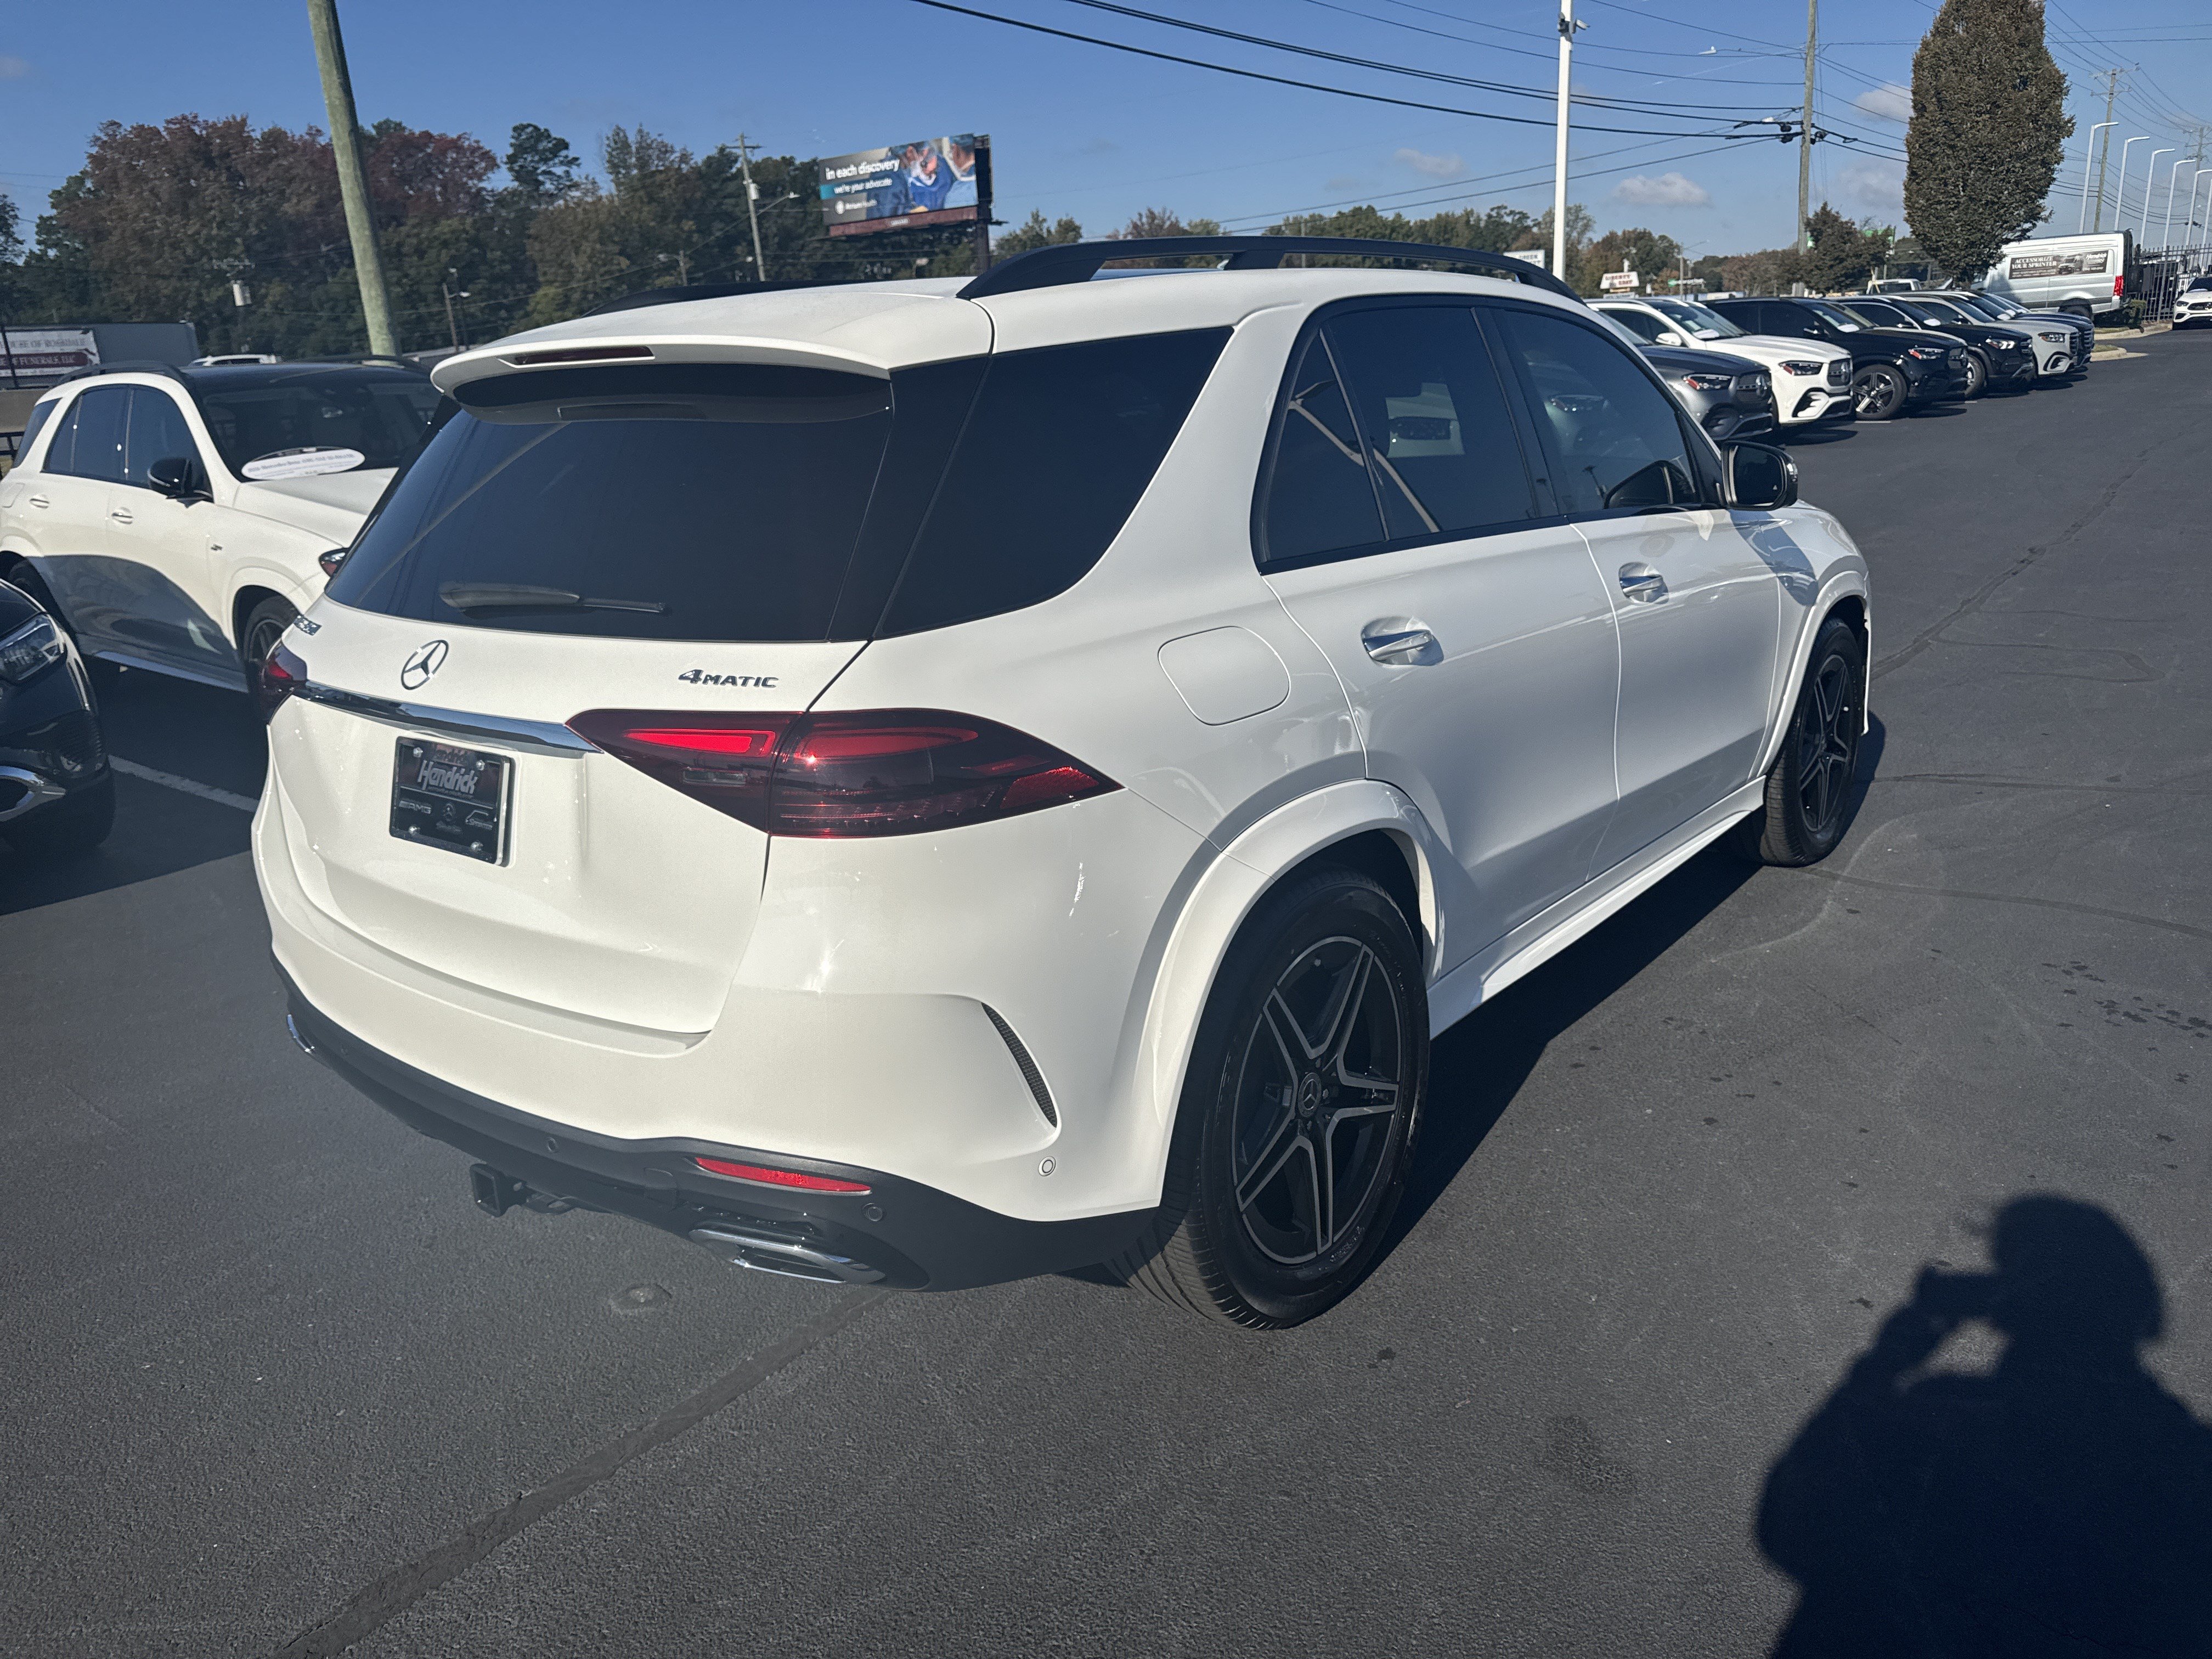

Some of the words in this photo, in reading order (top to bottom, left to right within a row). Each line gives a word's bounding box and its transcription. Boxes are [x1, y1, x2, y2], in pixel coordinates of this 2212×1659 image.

[825, 167, 836, 180] in
[836, 164, 857, 178] each
[858, 159, 900, 174] discovery
[865, 178, 893, 189] advocate
[678, 669, 779, 689] 4MATIC
[417, 760, 478, 794] Hendrick
